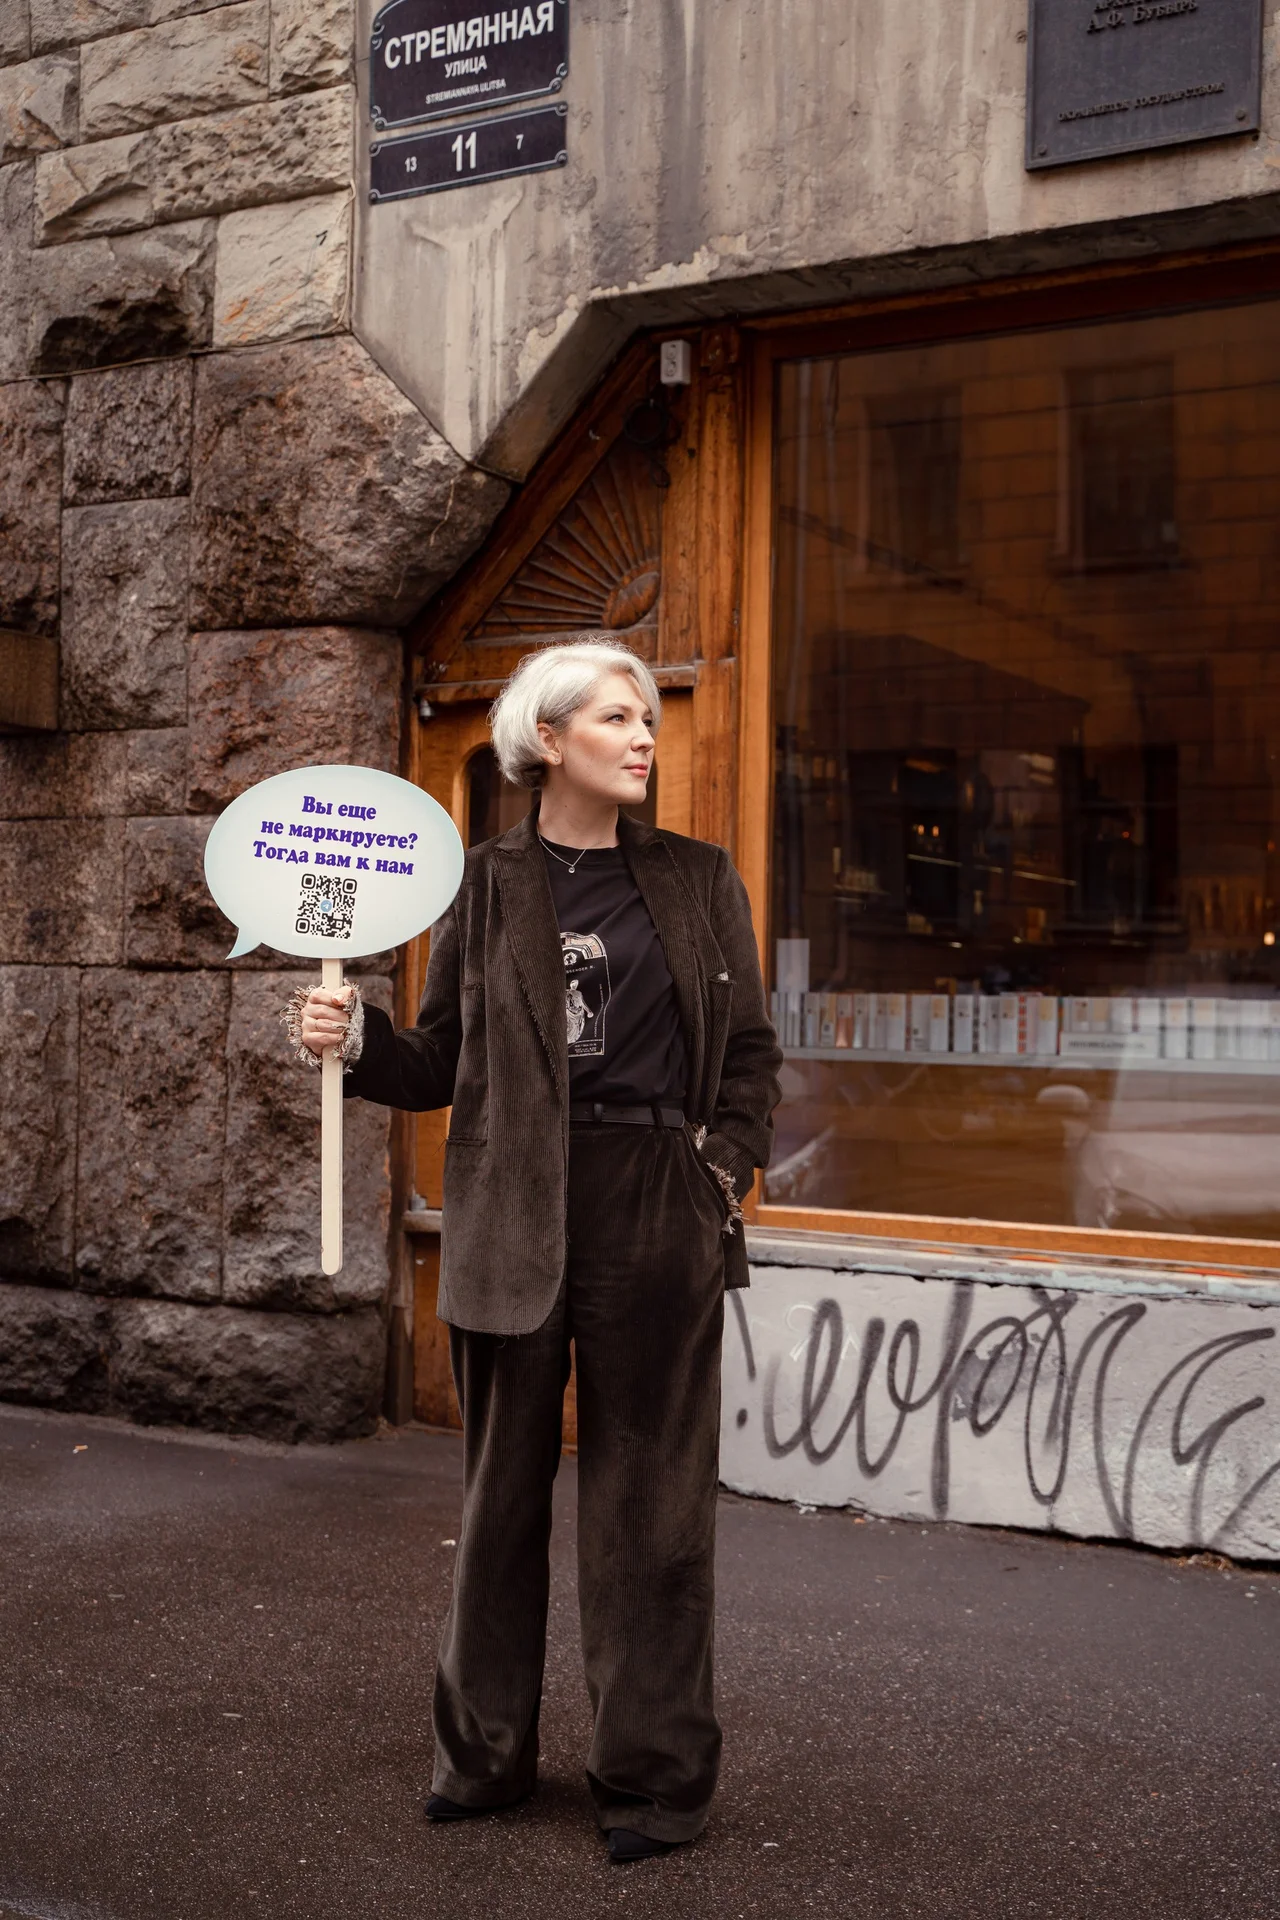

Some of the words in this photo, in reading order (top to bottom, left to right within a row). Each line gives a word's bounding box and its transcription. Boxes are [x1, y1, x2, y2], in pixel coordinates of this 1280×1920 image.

[384, 2, 555, 69] СТРЕМЯННАЯ
[444, 55, 487, 78] УЛИЦА
[480, 78, 506, 93] ULITSA
[405, 156, 417, 172] 13
[451, 131, 477, 172] 11
[516, 134, 524, 150] 7
[302, 796, 333, 817] Вы
[338, 804, 377, 821] еще
[261, 820, 284, 836] не
[289, 823, 419, 850] маркируете?
[253, 841, 309, 864] Тогда
[315, 852, 352, 868] вам
[356, 856, 370, 871] к
[375, 859, 415, 876] нам
